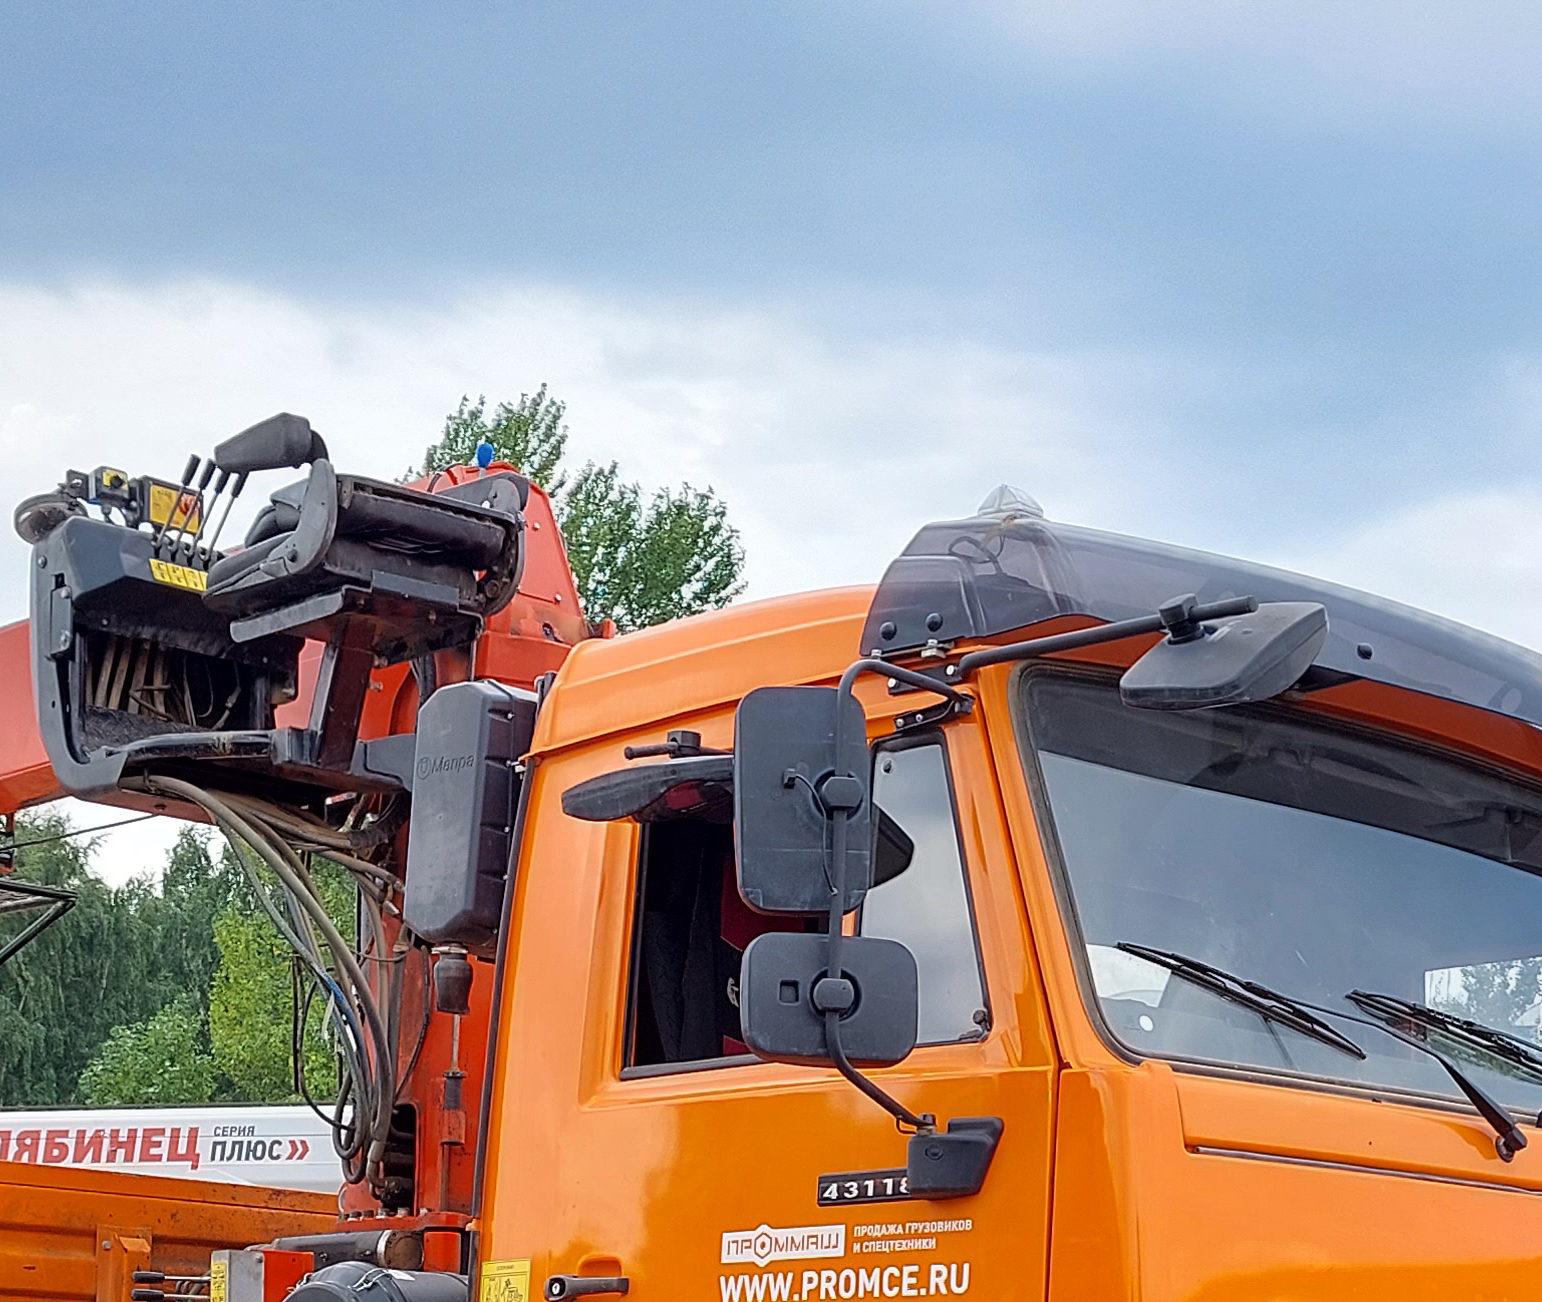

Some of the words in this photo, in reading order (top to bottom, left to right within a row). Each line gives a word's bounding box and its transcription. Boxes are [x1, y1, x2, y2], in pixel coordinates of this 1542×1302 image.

[213, 1125, 255, 1138] СЕРИЯ
[210, 1139, 282, 1162] ПЛЮС
[854, 1223, 903, 1237] ПРОДАЖА
[905, 1219, 972, 1235] ГРУЗОВИКОВ
[726, 1231, 840, 1259] ПРОММАШ
[853, 1242, 860, 1253] И
[862, 1237, 936, 1254] СПЕЦТЕХНИКИ
